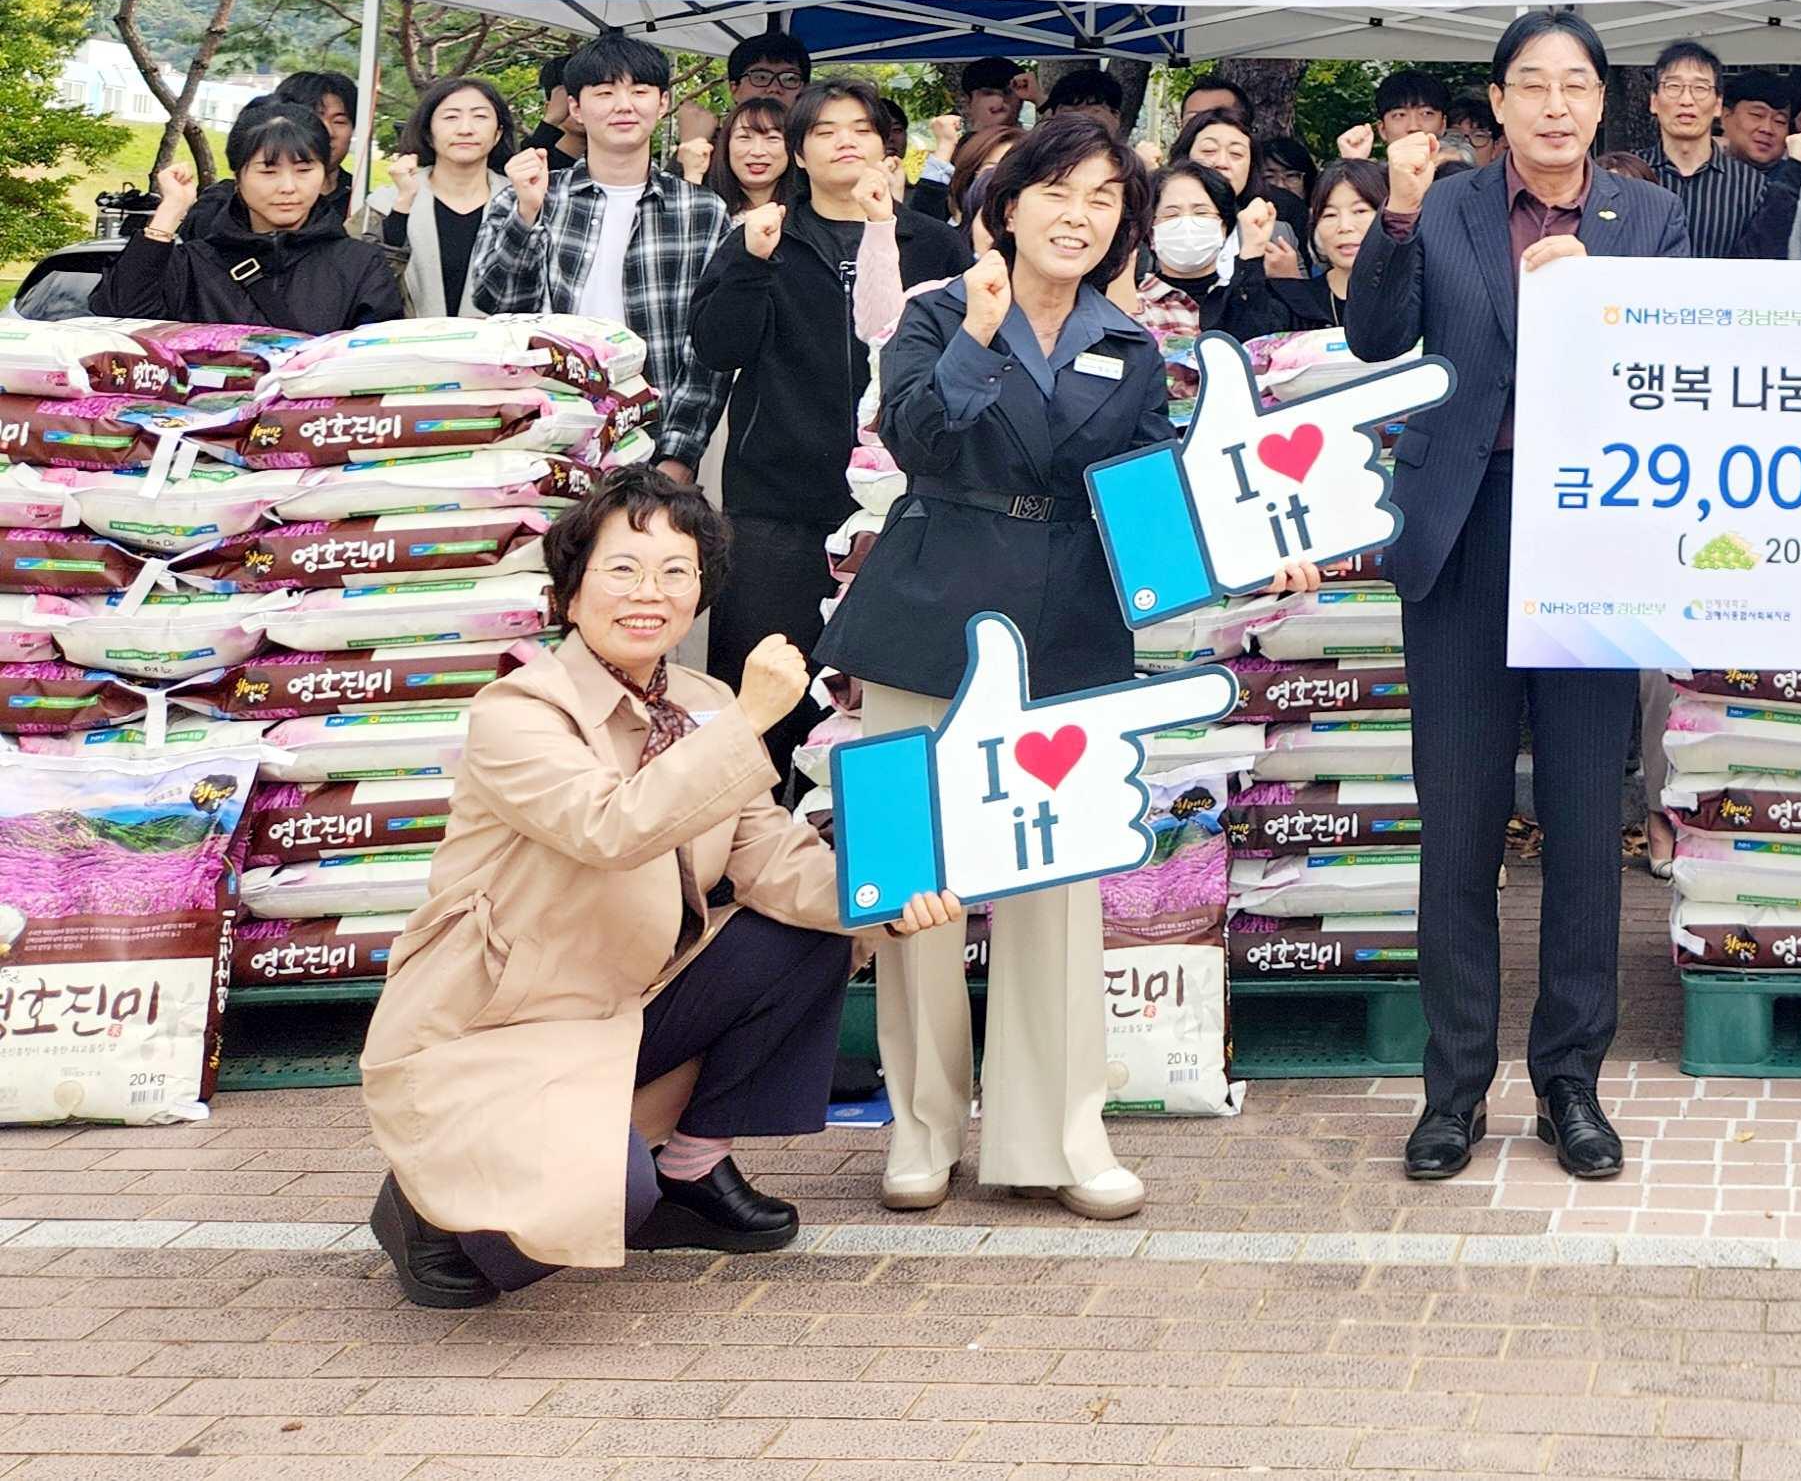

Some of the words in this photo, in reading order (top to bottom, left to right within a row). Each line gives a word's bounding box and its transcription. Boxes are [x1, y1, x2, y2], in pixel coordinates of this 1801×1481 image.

[1625, 308, 1733, 326] NH농협은행
[300, 413, 401, 447] 영호진미
[1221, 443, 1259, 503] I
[1266, 493, 1312, 558] it
[291, 539, 396, 573] 영호진미
[1540, 602, 1614, 615] NH농협은행
[287, 669, 392, 702] 영호진미
[1266, 676, 1359, 710] 영호진미
[977, 737, 1009, 804] I
[268, 813, 372, 849] 영호진미
[1013, 801, 1058, 871] it
[1265, 811, 1358, 844] 영호진미
[251, 943, 355, 978] 영호진미
[1247, 938, 1342, 971] 영호진미
[1104, 964, 1184, 1018] 진미
